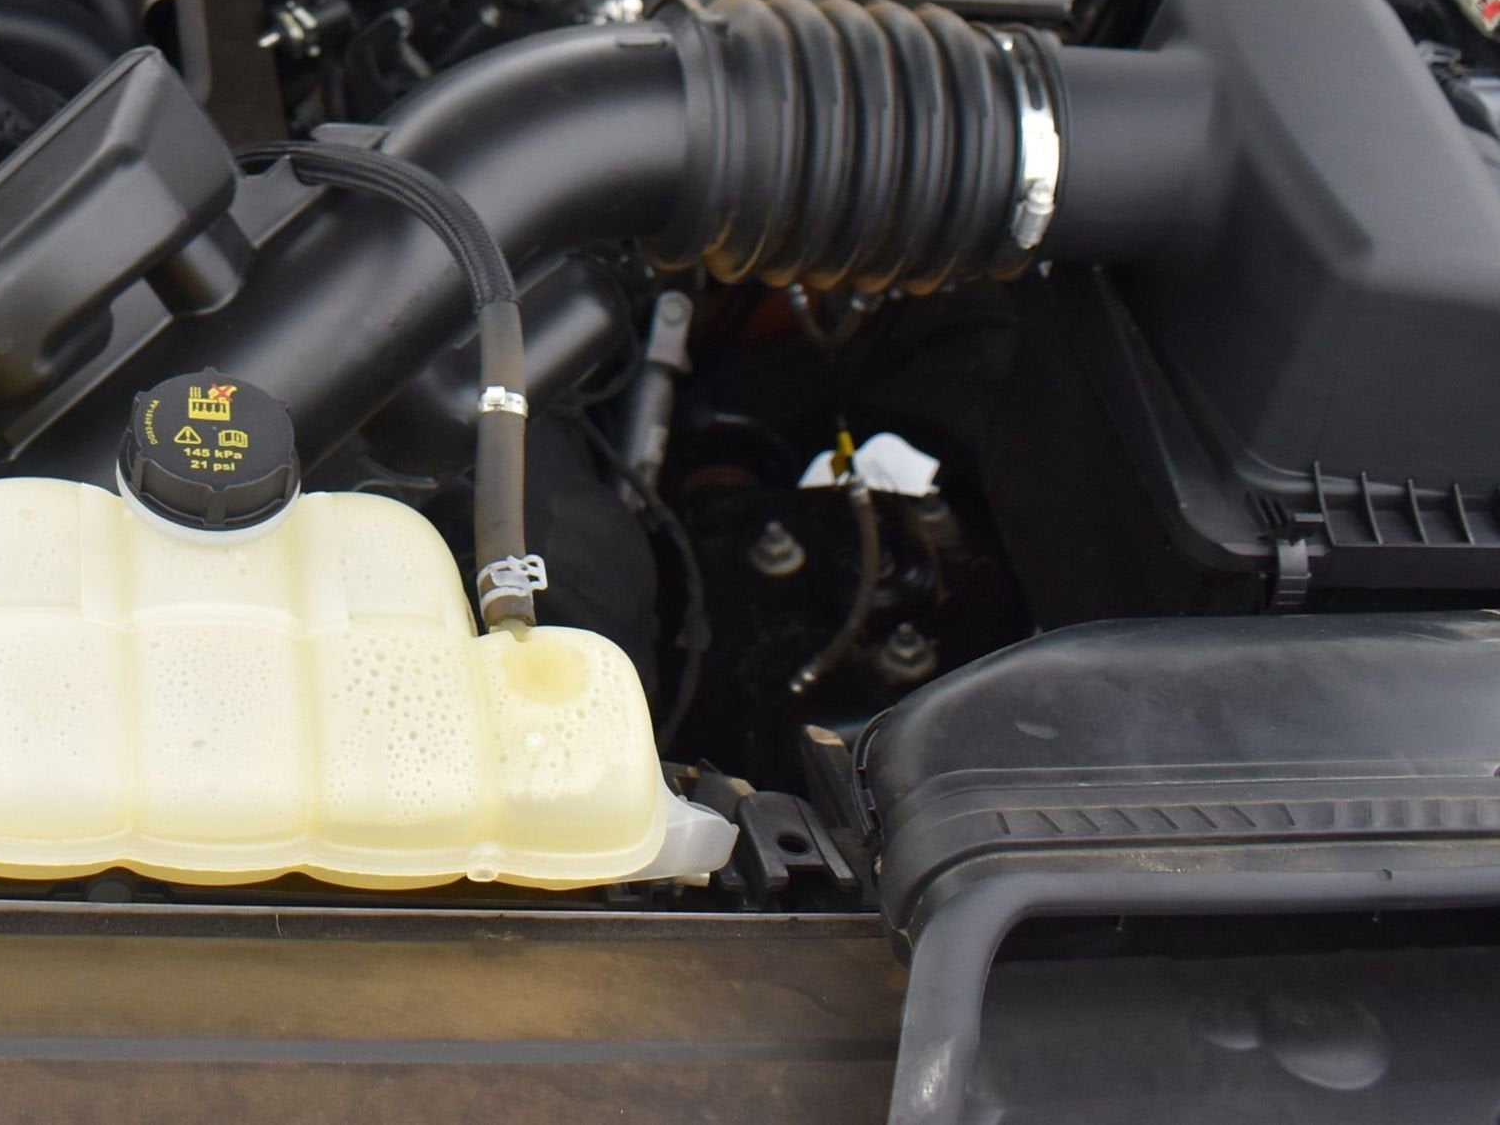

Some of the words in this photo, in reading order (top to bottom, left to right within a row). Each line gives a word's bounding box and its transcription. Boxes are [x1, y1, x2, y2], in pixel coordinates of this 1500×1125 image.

[183, 447, 210, 458] 145
[214, 449, 243, 460] kPa
[190, 459, 208, 469] 21
[213, 462, 235, 472] psi
